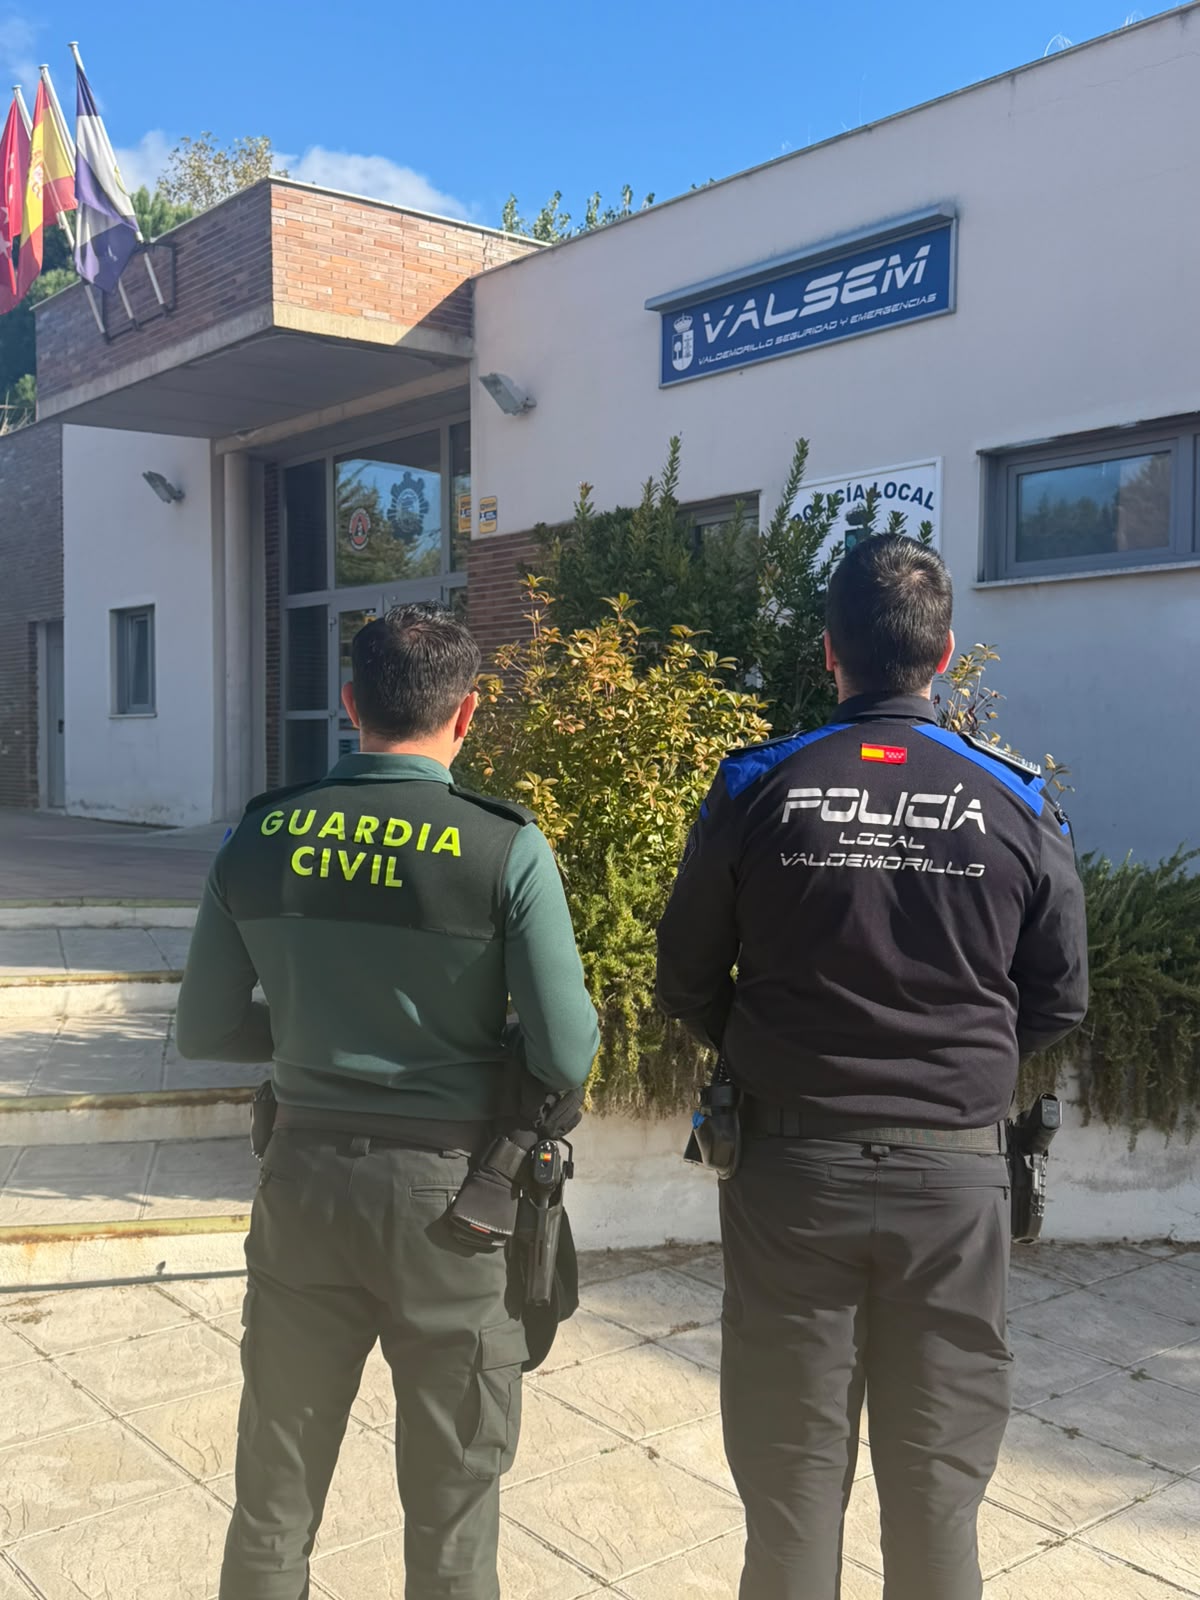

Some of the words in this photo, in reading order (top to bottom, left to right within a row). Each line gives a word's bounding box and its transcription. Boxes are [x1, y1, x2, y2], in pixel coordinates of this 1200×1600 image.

[702, 244, 930, 344] VALSEM
[698, 337, 774, 365] VALDEMORILLO
[775, 320, 837, 345] SEGURIDAD
[839, 317, 848, 330] Y
[850, 293, 937, 324] EMERGENCIAS
[790, 482, 865, 523] OCÍA
[872, 481, 935, 511] LOCAL
[781, 782, 986, 835] POLICÍA
[260, 808, 461, 857] GUARDIA
[838, 831, 925, 850] LOCAL
[290, 845, 403, 888] CIVIL
[780, 852, 986, 878] VALDEMORILLO
